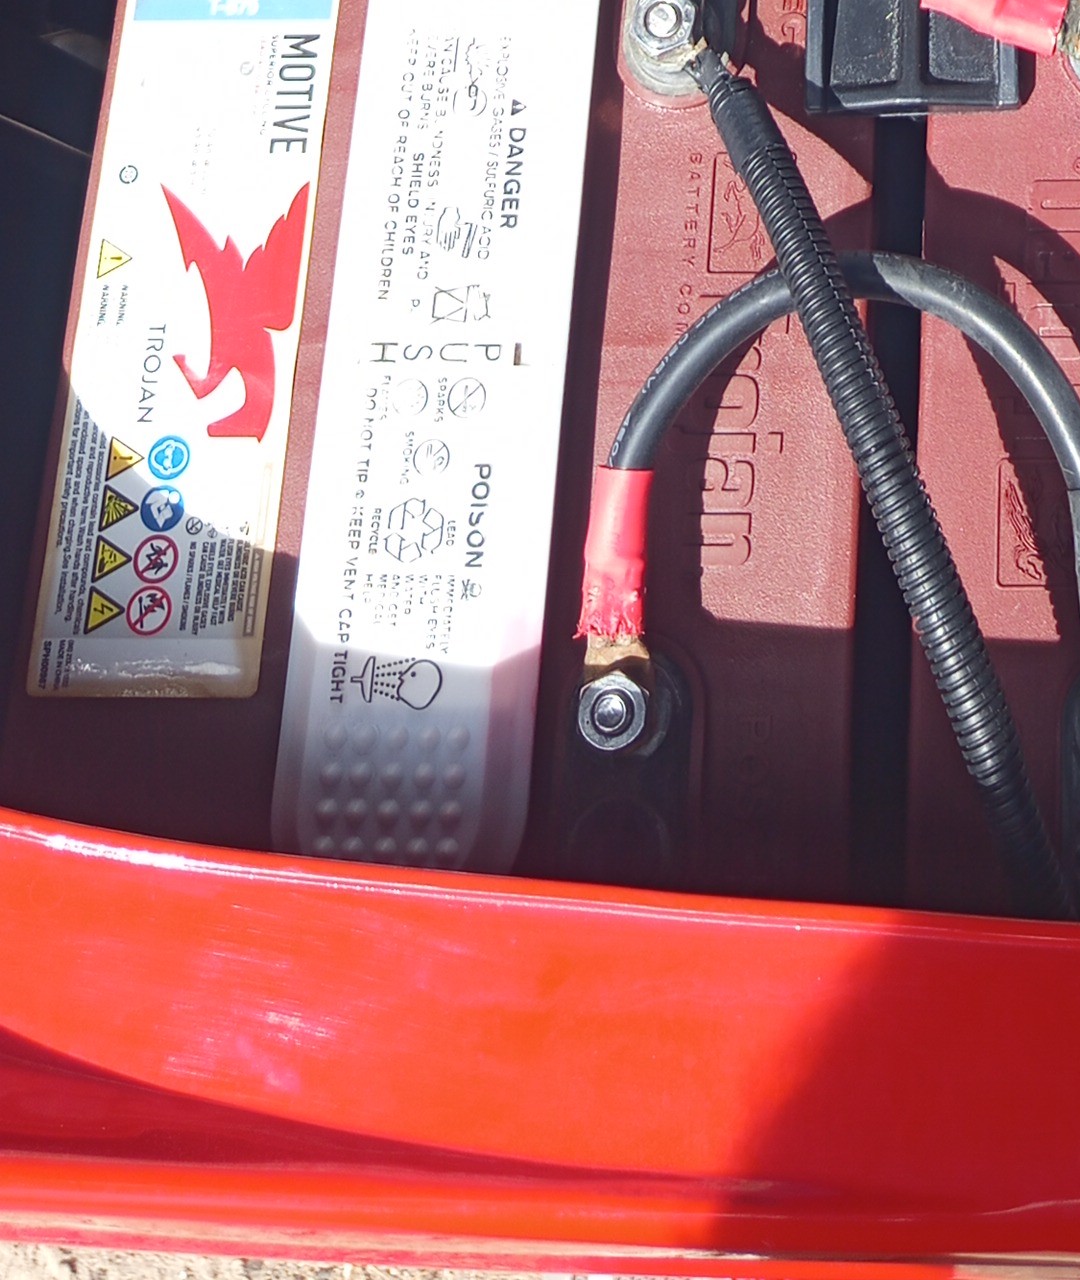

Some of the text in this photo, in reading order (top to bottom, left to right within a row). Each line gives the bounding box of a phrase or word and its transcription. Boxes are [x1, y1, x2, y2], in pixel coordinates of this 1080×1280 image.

[268, 34, 320, 154] MOTIVE
[500, 126, 527, 229] DANGER
[682, 152, 702, 268] BATTERY
[136, 322, 166, 423] TROJAN
[370, 342, 503, 362] PUSH
[464, 463, 493, 568] POISON
[329, 650, 348, 703] TIGHT
